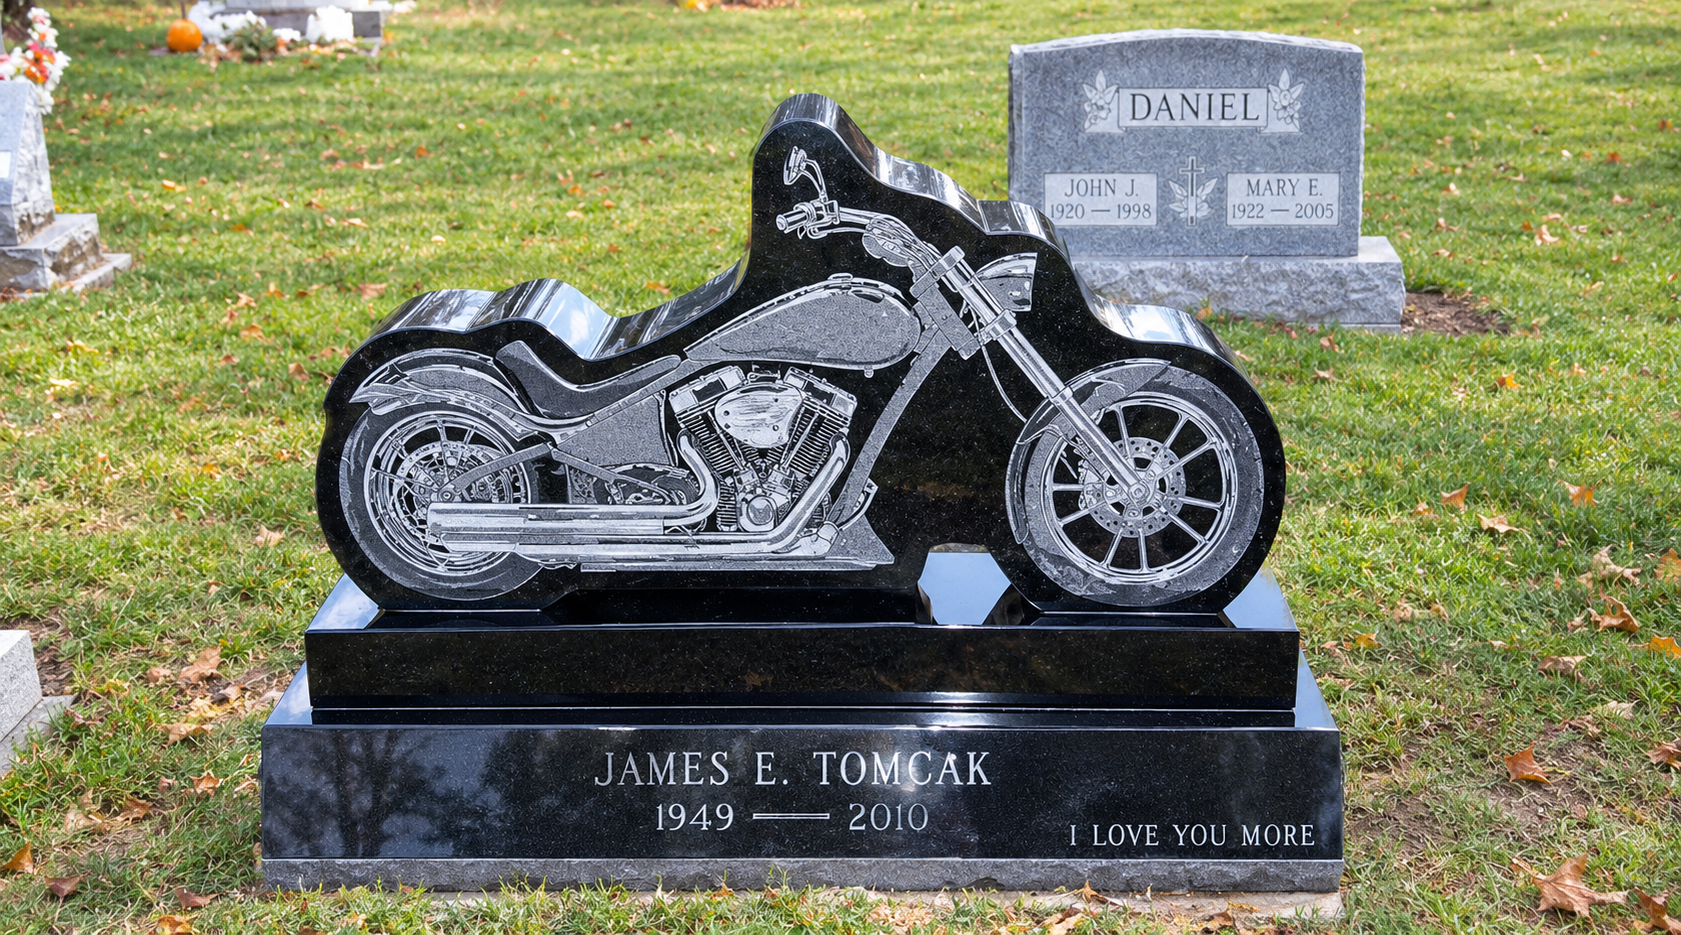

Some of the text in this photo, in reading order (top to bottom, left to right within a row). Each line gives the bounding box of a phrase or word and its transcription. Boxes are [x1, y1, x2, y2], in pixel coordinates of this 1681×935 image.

[1129, 92, 1260, 121] DANIEL
[1064, 178, 1139, 197] JOHN J.
[1246, 178, 1323, 197] MARY E.
[1049, 204, 1152, 219] 1920 1998
[1232, 203, 1334, 219] 1922 2005
[594, 751, 991, 786] JAMES E. TOMCAK
[655, 803, 929, 831] 1949 2010
[1070, 824, 1315, 846] I LOVE YOU MORE
